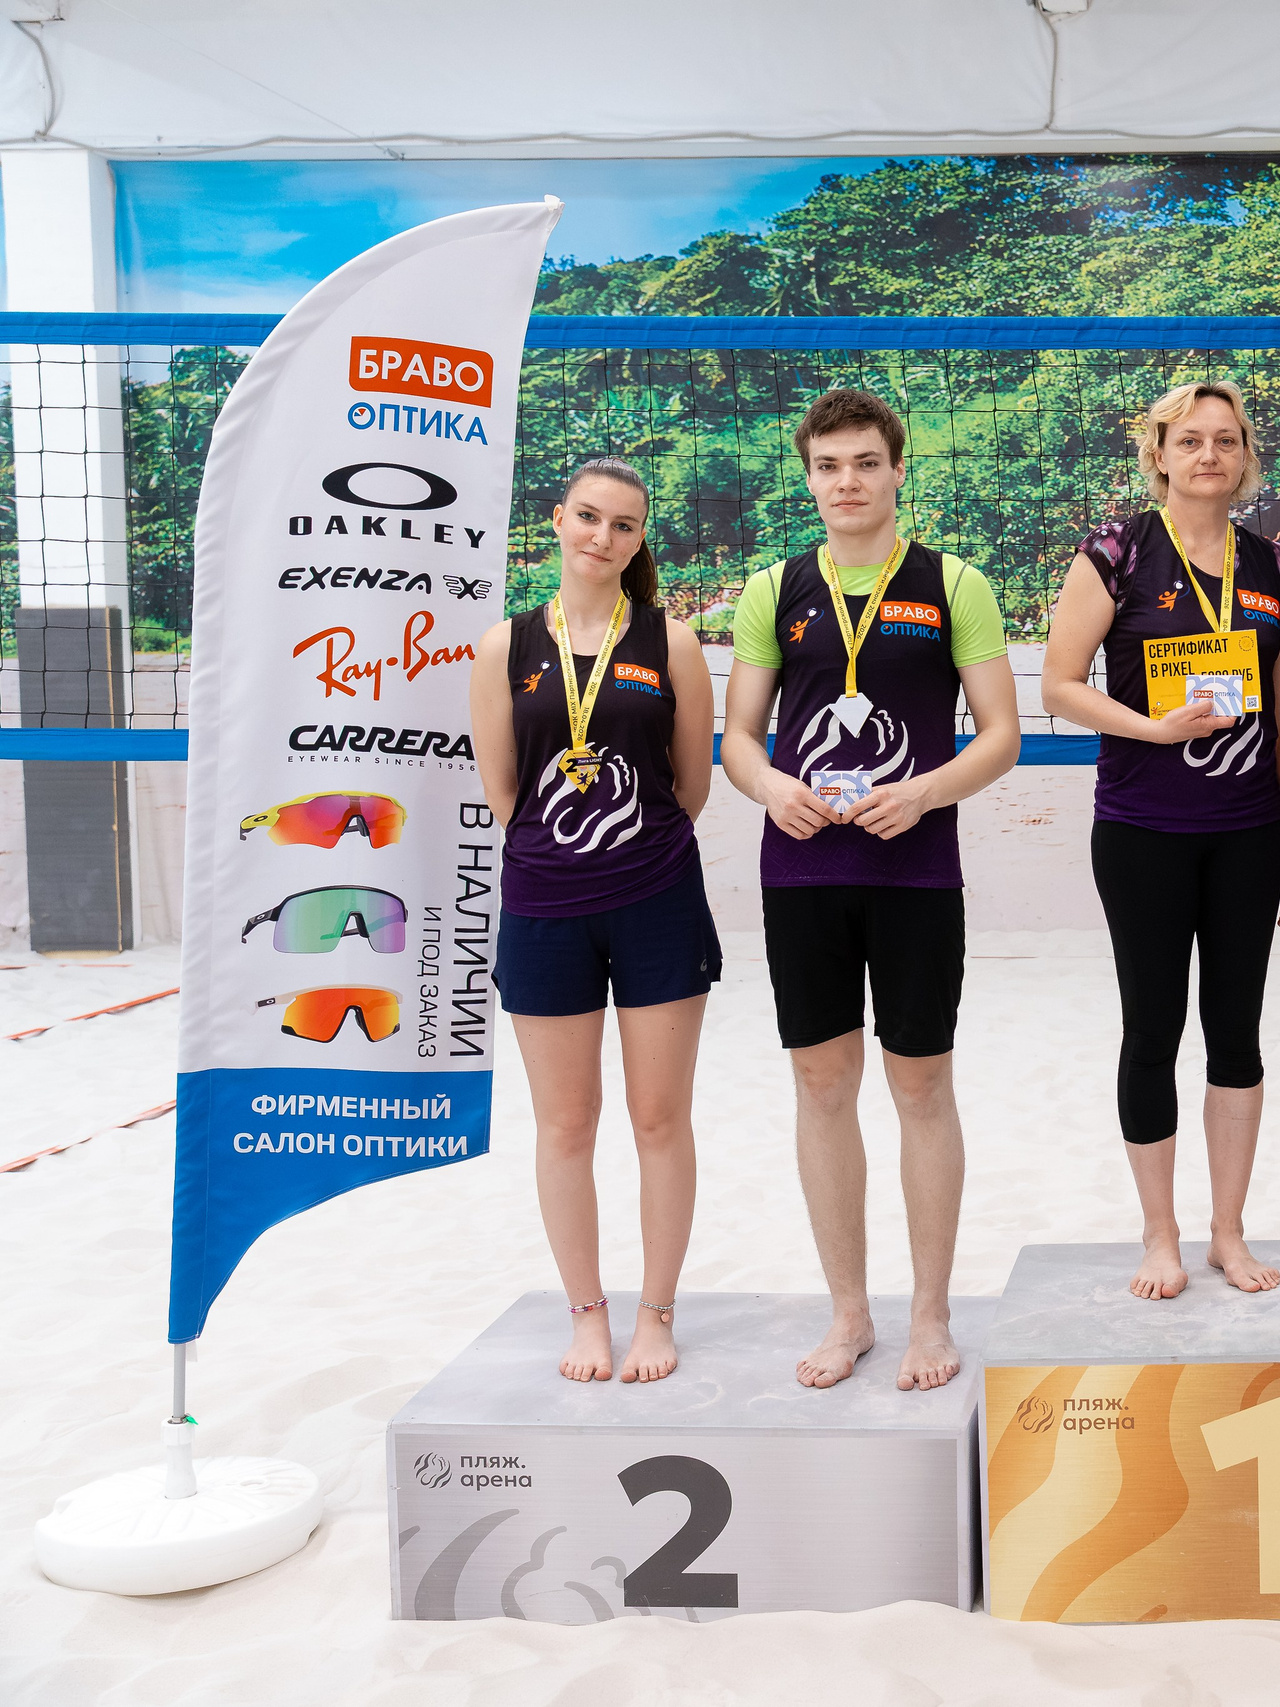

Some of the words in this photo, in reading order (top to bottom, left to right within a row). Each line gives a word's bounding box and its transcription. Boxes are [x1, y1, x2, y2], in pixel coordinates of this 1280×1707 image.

[358, 348, 485, 393] БРАВО
[347, 402, 488, 445] ОПТИКА
[289, 515, 486, 548] OAKLEY
[278, 566, 433, 595] EXENZA
[871, 584, 882, 604] сезона
[1241, 593, 1279, 614] БРАВО
[865, 604, 873, 618] 2025
[884, 605, 938, 621] БРАВО
[856, 623, 865, 638] 2026
[880, 623, 941, 642] ОПТИКА
[1148, 638, 1228, 659] СЕРТИФИКАТ
[617, 666, 658, 683] БРАВО
[1150, 663, 1159, 678] В
[1161, 661, 1195, 678] PIXEL
[615, 680, 662, 697] ОПТИКА
[288, 725, 475, 761] CARRERA
[287, 755, 361, 763] EYEWEAR
[374, 757, 425, 768] SINCE
[438, 762, 475, 772] 1956
[459, 802, 494, 829] В
[424, 906, 442, 924] И
[417, 928, 441, 978] ПОД
[449, 845, 493, 1057] НАЛИЧИИ
[417, 984, 439, 1058] ЗАКАЗ
[250, 1093, 452, 1119] ФИРМЕННЫЙ
[232, 1132, 335, 1155] САЛОН
[342, 1134, 468, 1158] ОПТИКИ
[1063, 1398, 1129, 1411] пляж.
[1063, 1417, 1135, 1435] арена
[460, 1456, 526, 1469] пляж.
[460, 1474, 532, 1491] арена
[616, 1454, 739, 1608] 2
